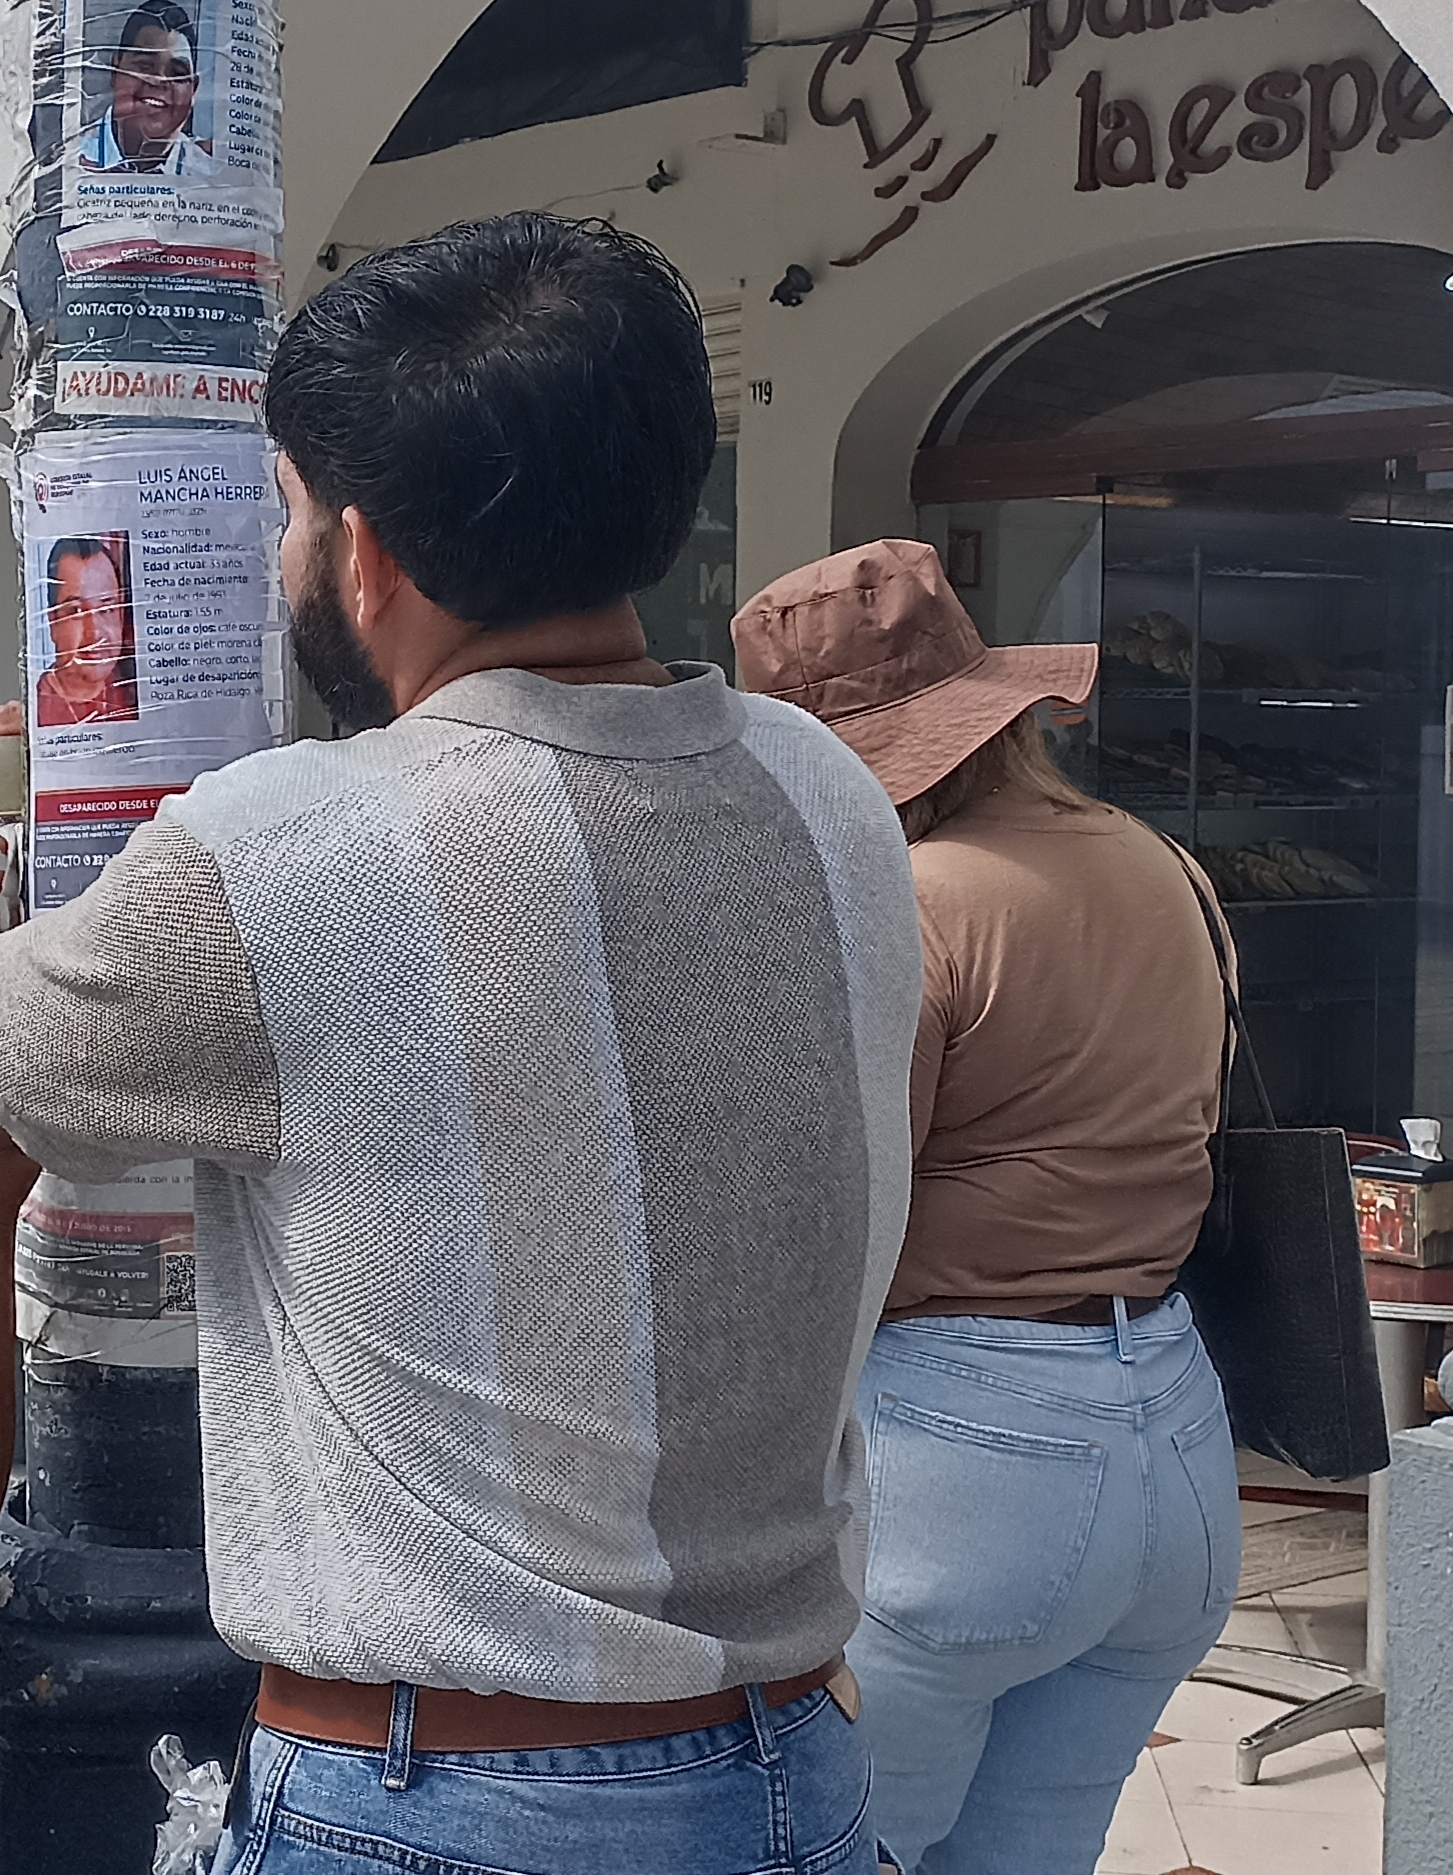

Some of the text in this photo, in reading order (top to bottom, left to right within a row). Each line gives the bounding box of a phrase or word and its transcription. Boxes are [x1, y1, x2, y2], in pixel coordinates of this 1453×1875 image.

[217, 204, 230, 213] en
[232, 206, 240, 214] el
[201, 215, 252, 228] perforación
[186, 256, 218, 267] DESDE
[67, 303, 133, 316] CONTACTO
[149, 305, 170, 317] 228
[173, 306, 195, 318] 319
[198, 307, 225, 320] 3187
[191, 375, 210, 400] A
[751, 381, 773, 405] 119
[138, 463, 228, 484] LUIS ÁNGEL
[139, 486, 210, 503] MANCHA
[141, 528, 211, 539] Sexo: hombre
[142, 542, 213, 555] Nacionalidad:
[143, 561, 170, 571] Edad
[144, 577, 176, 588] Fecha
[177, 576, 192, 586] de
[145, 609, 193, 619] Estatura:
[146, 625, 173, 636] Color
[176, 624, 190, 634] de
[192, 623, 216, 636] ojos:
[147, 641, 174, 652] Color
[177, 641, 191, 650] de
[193, 640, 215, 652] piel:
[216, 640, 252, 648] morena
[148, 657, 191, 668] Cabello:
[149, 676, 179, 686] Lugar
[181, 673, 196, 683] de
[176, 688, 198, 700] Rica
[200, 688, 214, 699] de
[59, 801, 117, 814] DESAPARECIDO
[118, 799, 149, 810] DESDE
[35, 854, 81, 869] CONTACTO
[149, 1175, 168, 1184] con
[171, 1174, 180, 1184] la
